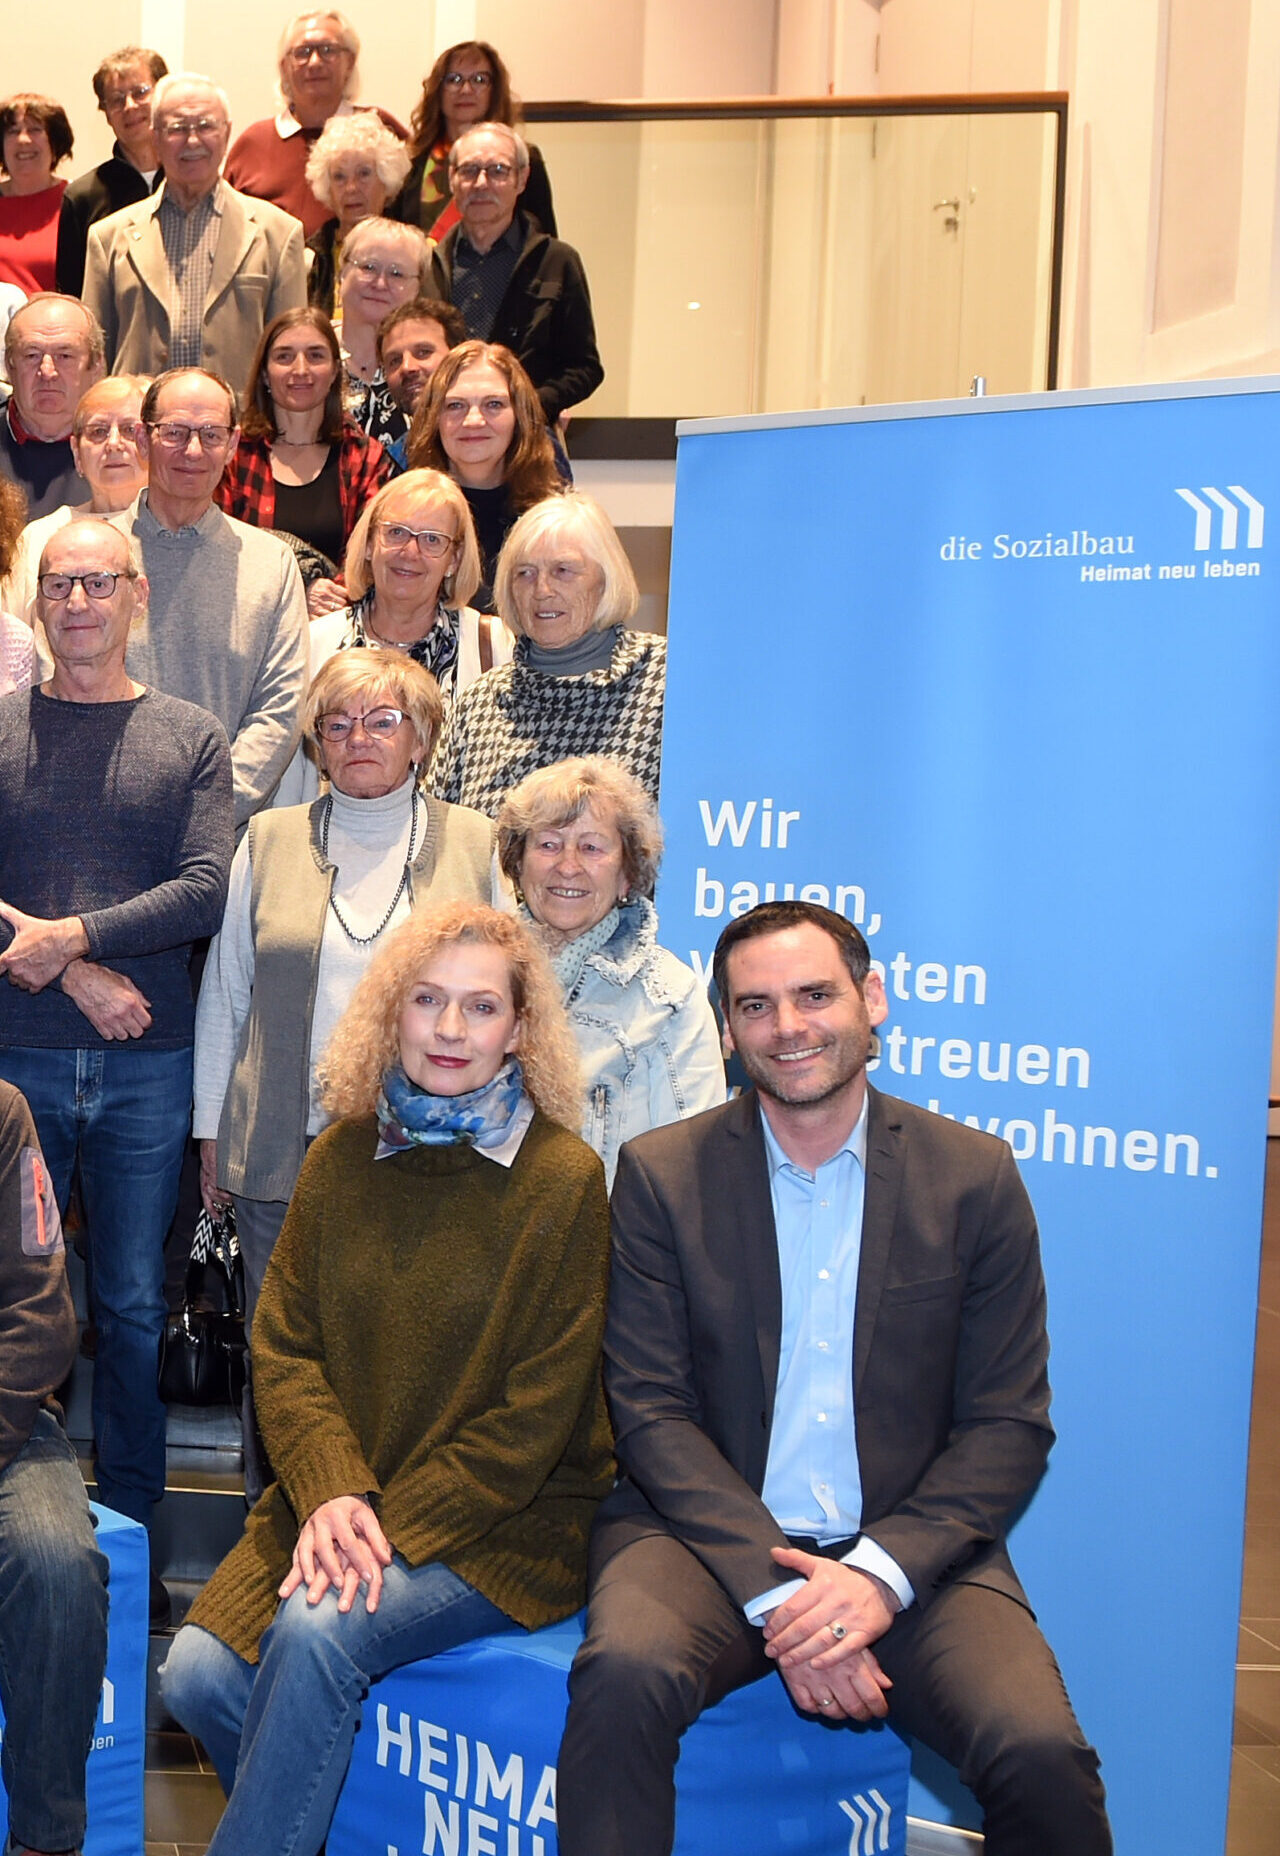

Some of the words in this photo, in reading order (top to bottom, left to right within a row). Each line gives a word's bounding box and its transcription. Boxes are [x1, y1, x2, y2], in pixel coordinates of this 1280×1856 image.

[940, 536, 982, 561] die
[993, 530, 1135, 559] Sozialbau
[1080, 564, 1152, 582] Heimat
[1158, 564, 1196, 580] neu
[1203, 559, 1261, 578] leben
[698, 798, 801, 849] Wir
[865, 1025, 1090, 1089] treuen
[376, 1703, 557, 1828] HEIMA
